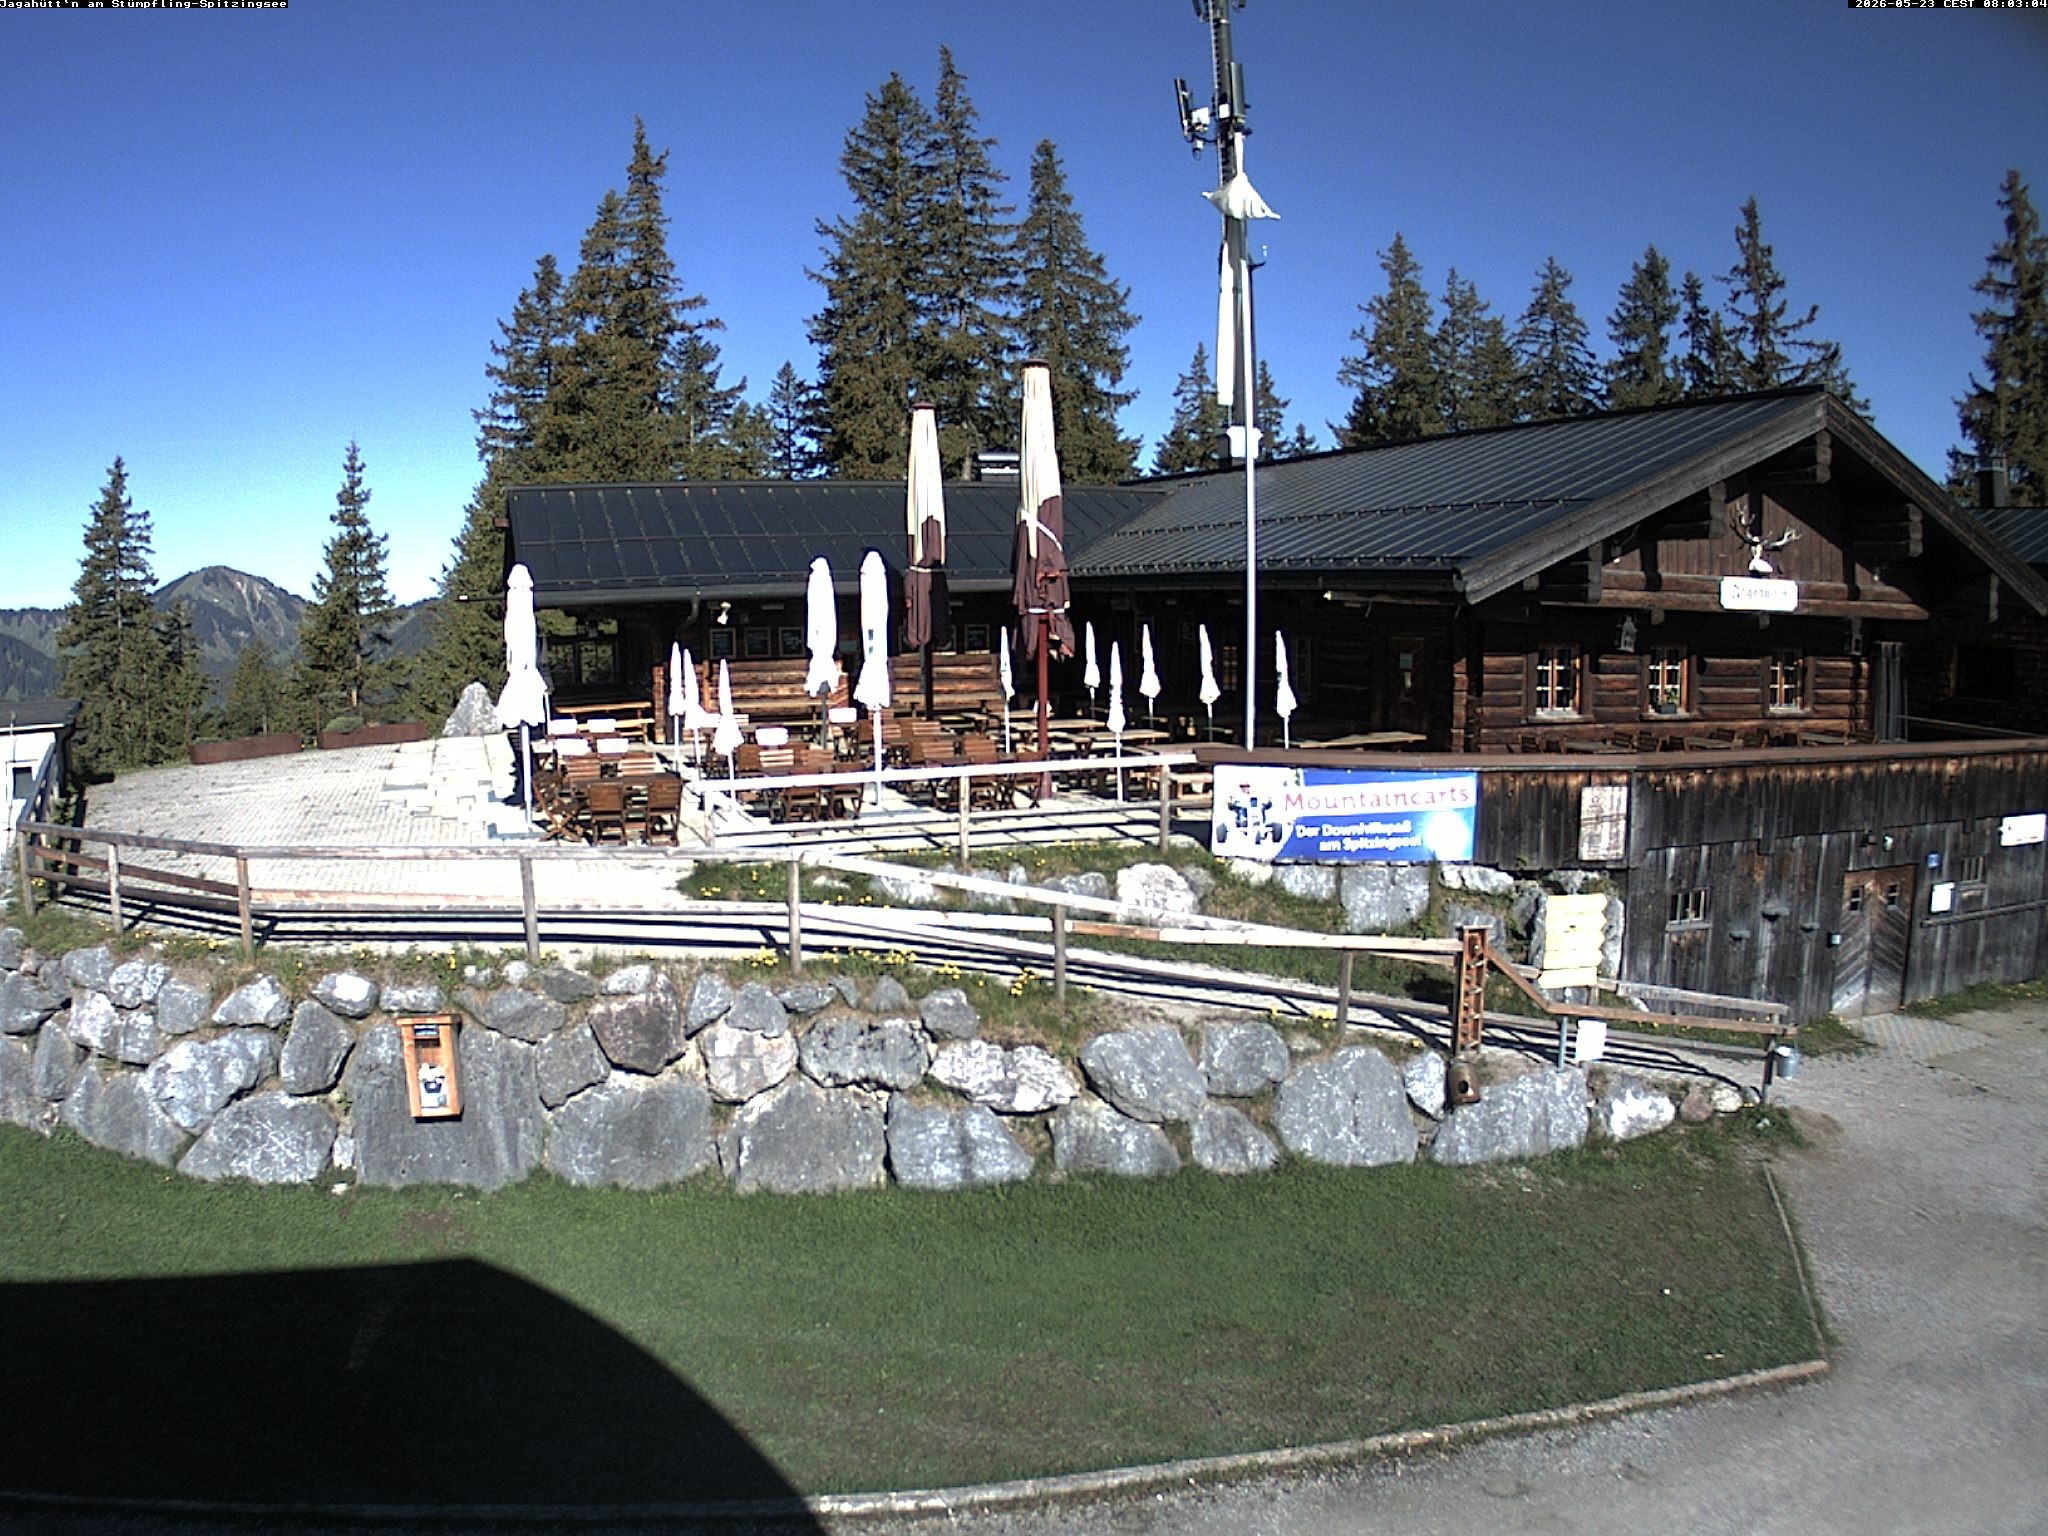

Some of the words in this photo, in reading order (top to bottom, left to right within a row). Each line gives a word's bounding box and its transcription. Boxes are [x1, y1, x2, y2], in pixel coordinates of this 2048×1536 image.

[1284, 786, 1469, 811] Mountaincarts
[1295, 824, 1320, 838] Der
[1319, 841, 1342, 851] am
